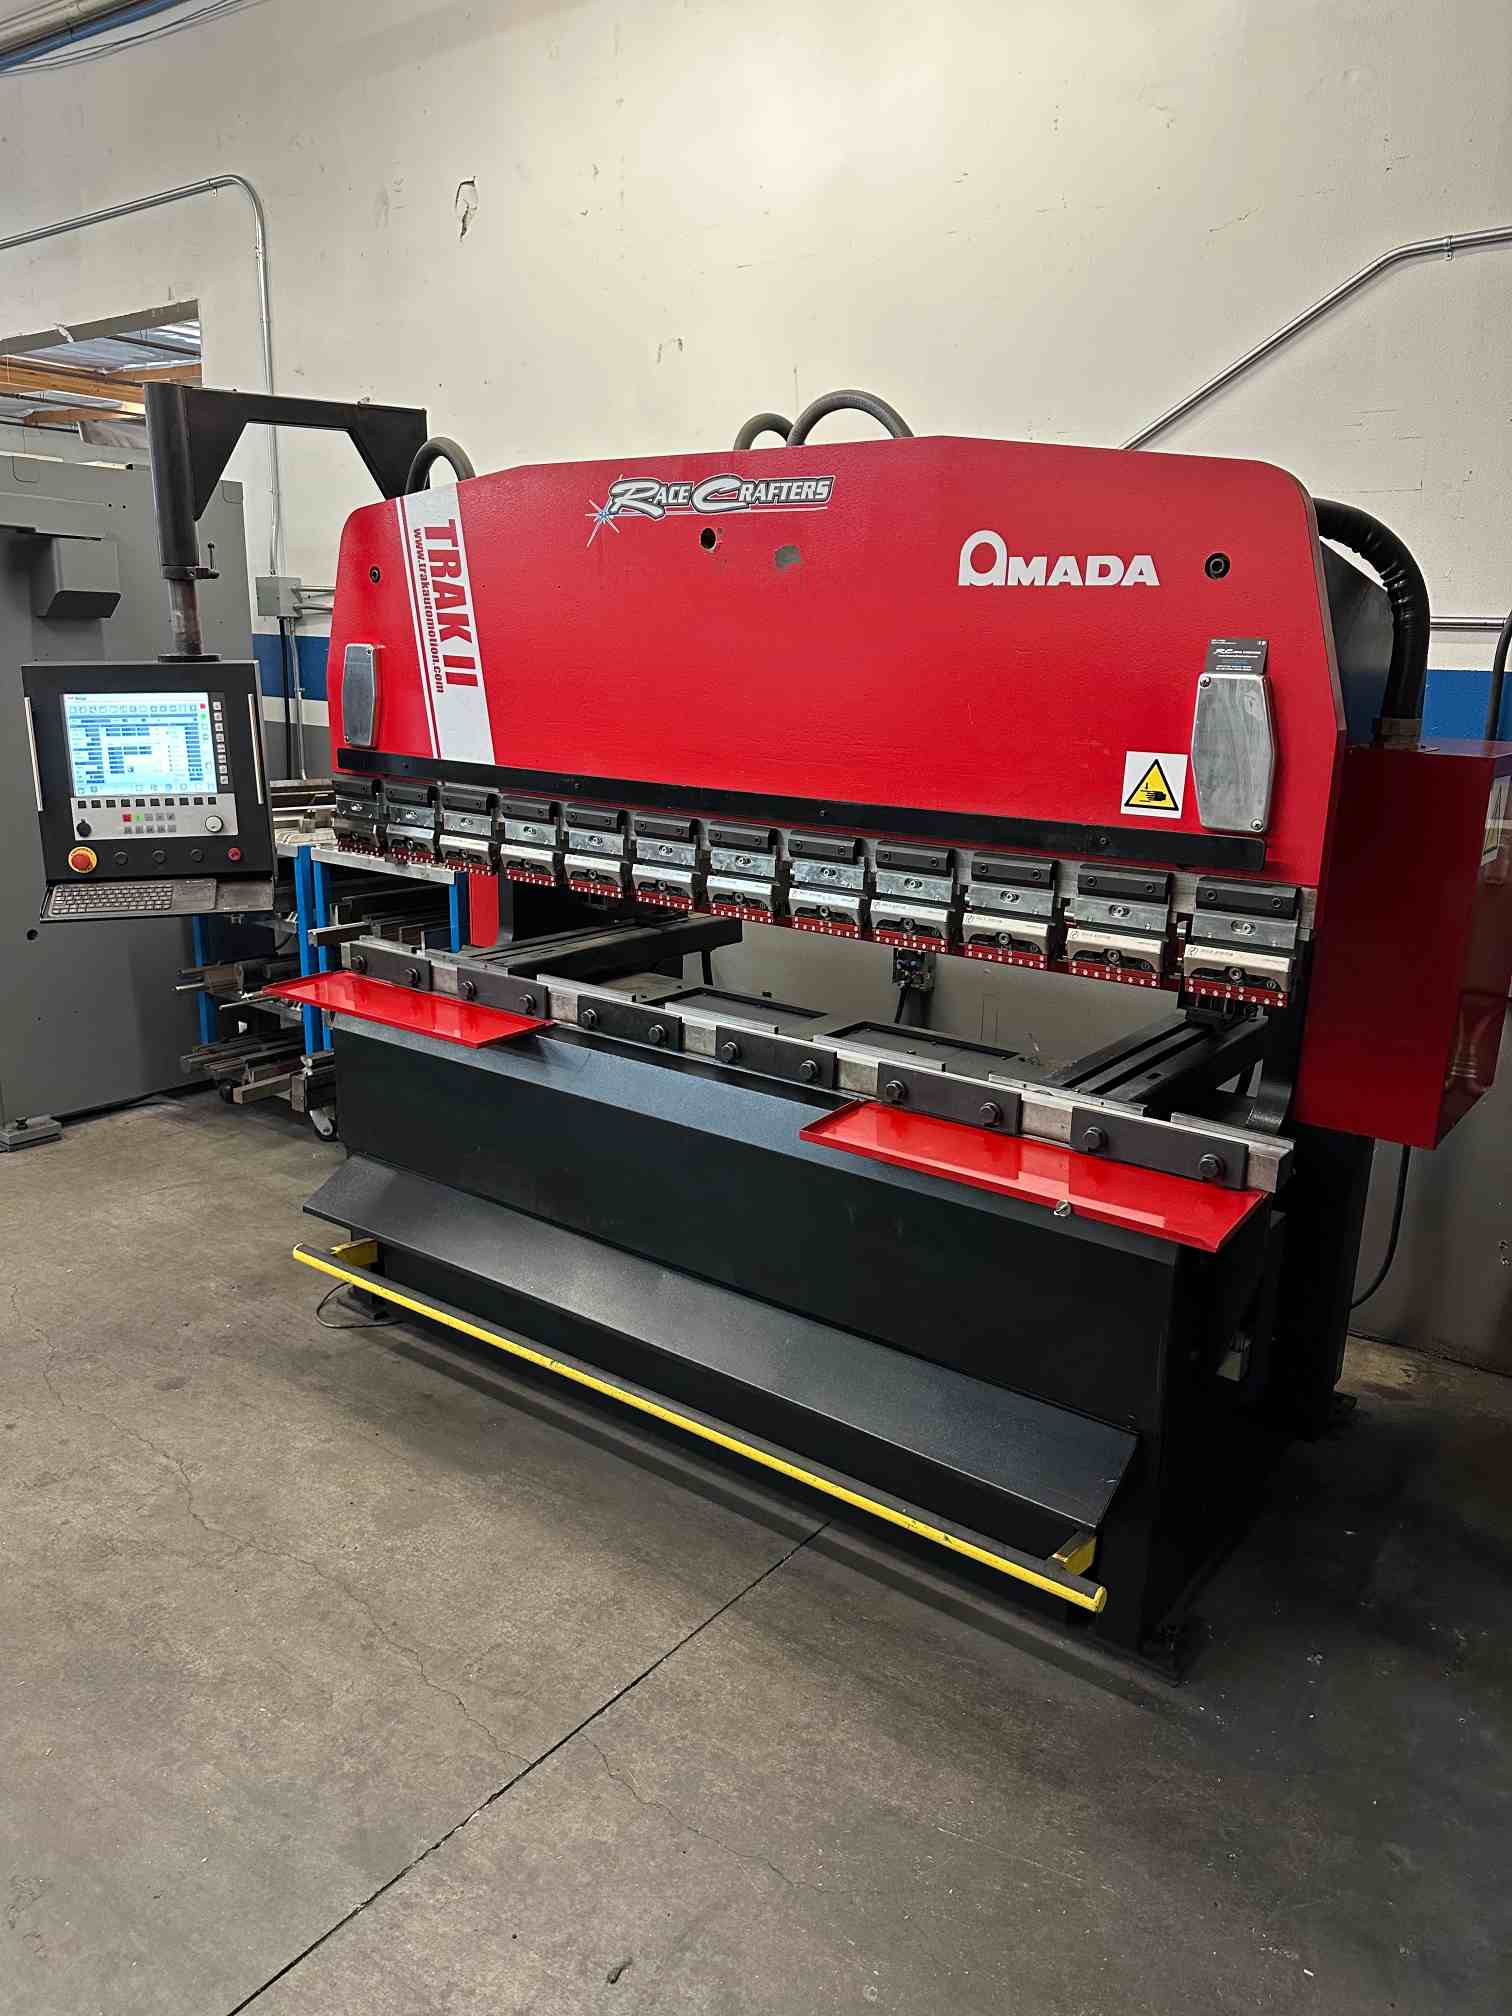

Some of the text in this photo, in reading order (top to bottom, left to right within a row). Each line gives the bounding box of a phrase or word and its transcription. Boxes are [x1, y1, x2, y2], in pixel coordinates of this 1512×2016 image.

[413, 528, 444, 694] www.trakautomotion.com
[424, 518, 478, 687] TRAK II
[958, 529, 1160, 586] AMADA
